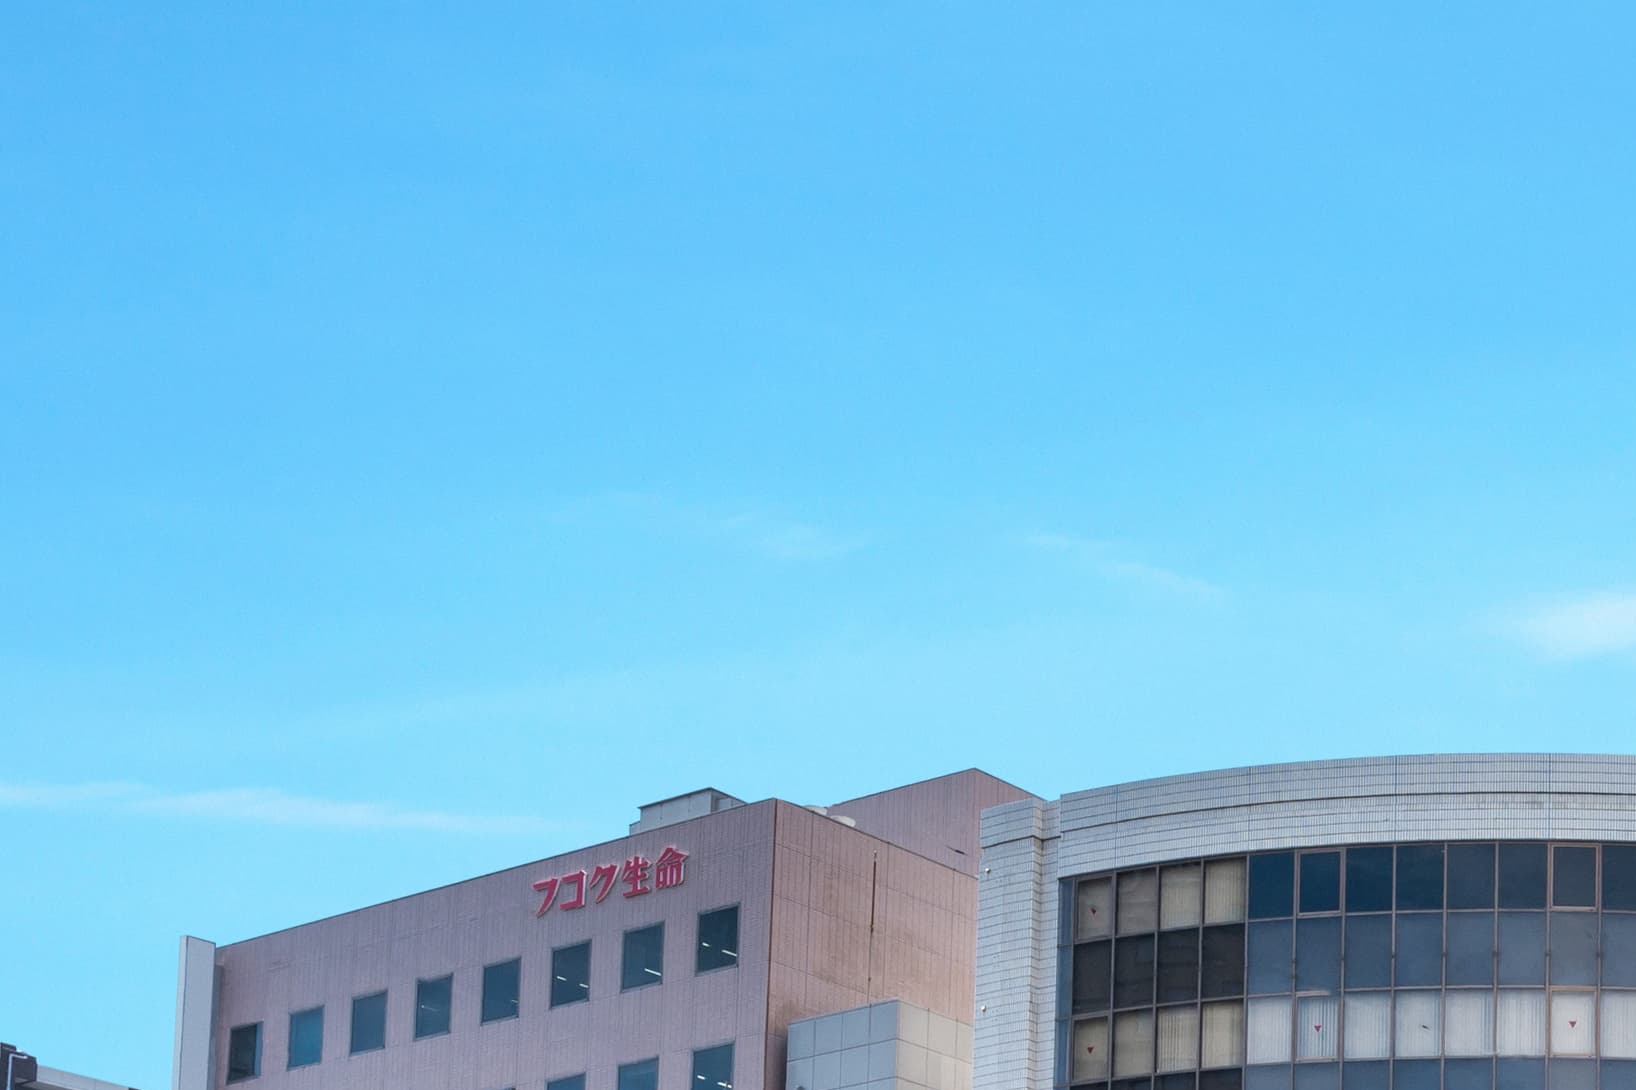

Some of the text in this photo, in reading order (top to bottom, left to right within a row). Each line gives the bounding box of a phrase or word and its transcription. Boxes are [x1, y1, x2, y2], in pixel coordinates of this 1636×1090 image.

[532, 847, 689, 919] フコク生命
